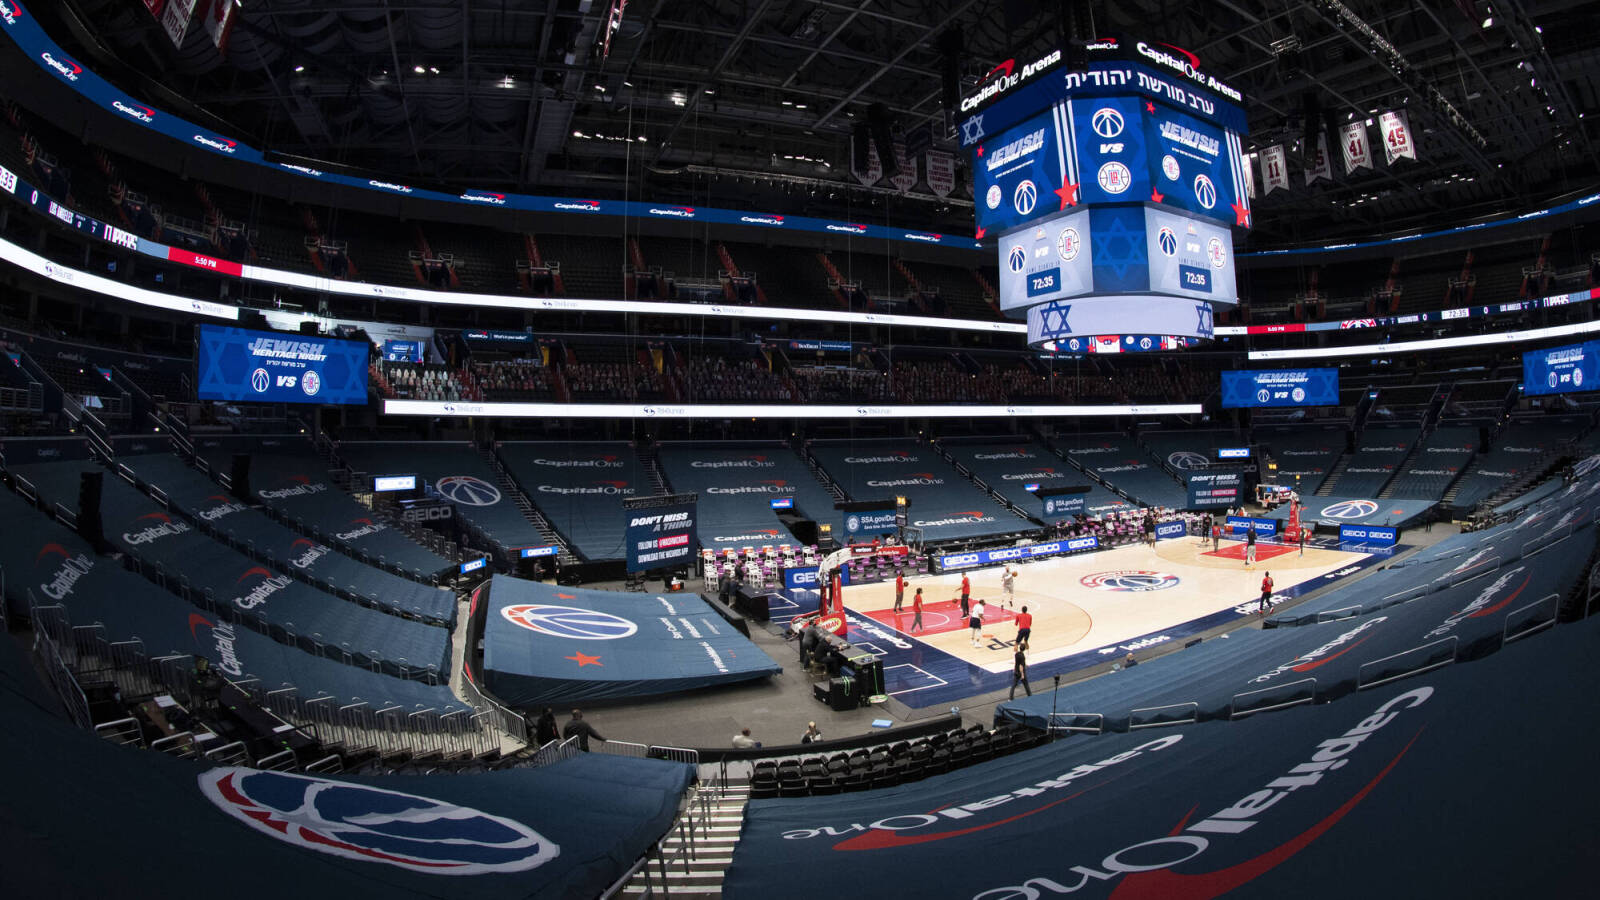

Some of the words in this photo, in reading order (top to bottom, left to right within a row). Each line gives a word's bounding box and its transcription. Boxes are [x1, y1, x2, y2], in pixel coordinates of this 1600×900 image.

[1021, 50, 1061, 80] Arena
[1065, 70, 1131, 90] יהודית
[1137, 72, 1186, 104] מורשת
[1208, 77, 1242, 101] Arena
[1188, 93, 1214, 115] ערב
[1160, 121, 1219, 151] JEWISH
[1388, 127, 1406, 147] 45
[987, 128, 1044, 166] JEWISH
[1349, 139, 1364, 157] 41
[1268, 161, 1280, 179] 11
[31, 190, 38, 204] 0
[208, 259, 216, 268] PM
[1033, 275, 1054, 290] 72:35
[1186, 271, 1205, 285] 72:35
[1422, 313, 1427, 321] 0
[1483, 306, 1488, 314] 0
[248, 338, 324, 355] JEWISH
[252, 349, 298, 359] HERITAGE
[298, 352, 328, 362] NIGHT
[1545, 347, 1583, 363] JEWISH
[276, 375, 297, 387] VS
[1253, 372, 1307, 380] JEWISH
[1560, 374, 1571, 382] VS
[1274, 391, 1288, 399] VS
[1220, 449, 1248, 457] GEICO
[404, 506, 452, 522] GEICO
[630, 515, 663, 527] DON'T
[663, 512, 688, 523] MISS
[653, 524, 660, 532] A
[663, 520, 692, 530] THING
[1158, 524, 1182, 535] GEICO
[1343, 529, 1366, 537] GEICO
[1369, 531, 1393, 539] GEICO
[527, 547, 552, 557] GEICO
[943, 554, 978, 566] GEICO
[989, 549, 1021, 560] GEICO
[1031, 543, 1060, 554] GEICO
[1068, 538, 1095, 549] GEICO
[464, 560, 482, 571] GEICO
